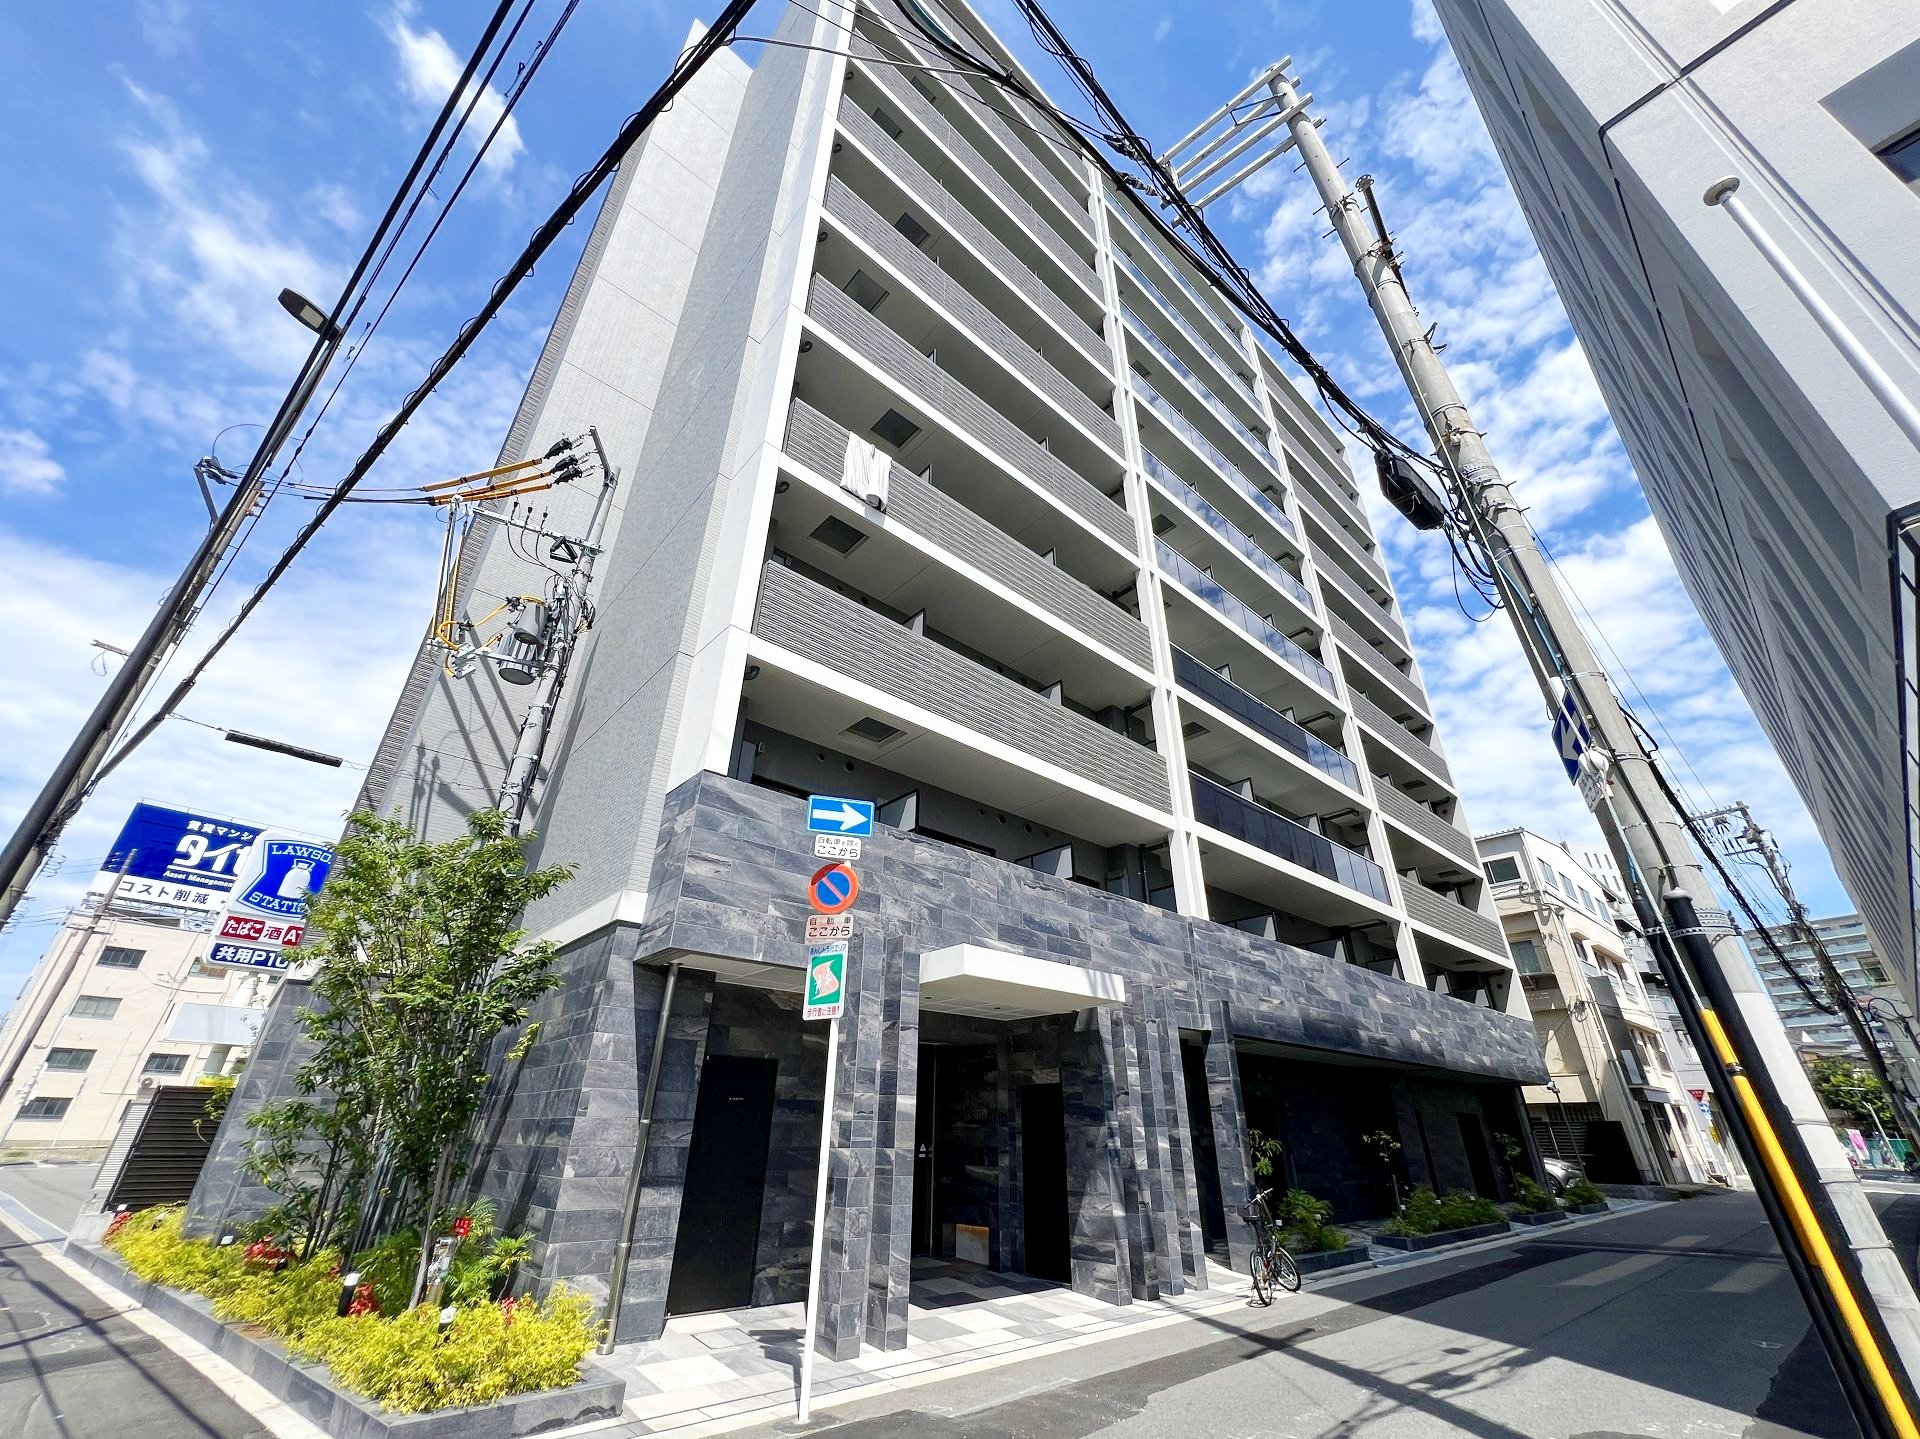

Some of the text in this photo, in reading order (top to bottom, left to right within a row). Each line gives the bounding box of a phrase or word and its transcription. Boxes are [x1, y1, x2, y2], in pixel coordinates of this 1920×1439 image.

[272, 845, 332, 865] LAWSO
[817, 845, 858, 857] ここから
[163, 870, 187, 880] Asset
[223, 919, 263, 937] たばこ
[263, 926, 284, 940] 酒
[809, 926, 850, 936] ここから
